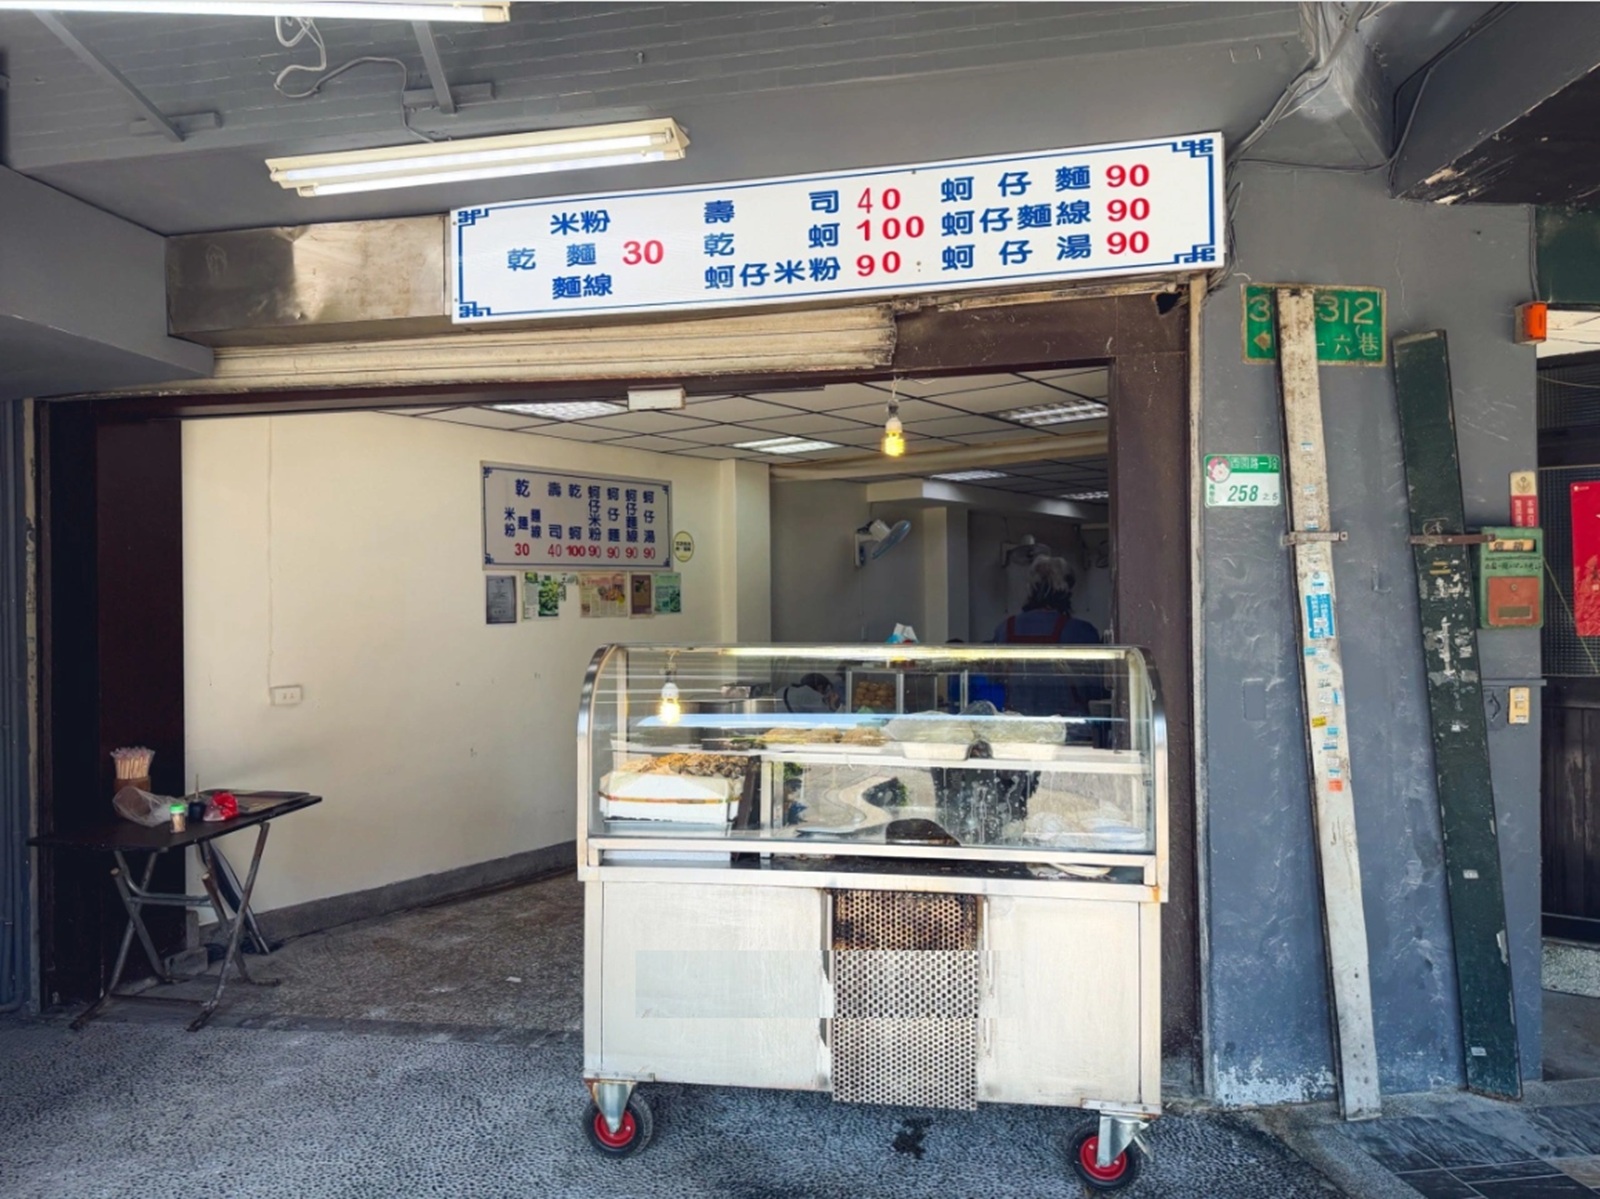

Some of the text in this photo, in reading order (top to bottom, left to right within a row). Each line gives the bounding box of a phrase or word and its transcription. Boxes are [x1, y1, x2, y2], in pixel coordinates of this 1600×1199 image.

[1105, 164, 1150, 188] 90
[857, 187, 901, 214] 40
[550, 209, 611, 235] 米粉
[856, 216, 925, 242] 100
[941, 198, 1150, 237] 蚵仔麵線 90
[622, 240, 664, 266] 30
[1106, 231, 1150, 255] 90
[704, 250, 901, 290] 蚵仔米粉 90
[552, 273, 613, 300] 麵線
[1227, 485, 1259, 502] 258
[504, 507, 516, 538] 米粉
[530, 509, 542, 539] 麵線
[514, 543, 530, 557] 30
[547, 544, 562, 558] 40
[566, 545, 586, 558] 100
[588, 545, 601, 558] 90
[607, 546, 620, 559] 90
[625, 546, 638, 559] 90
[643, 547, 656, 559] 90
